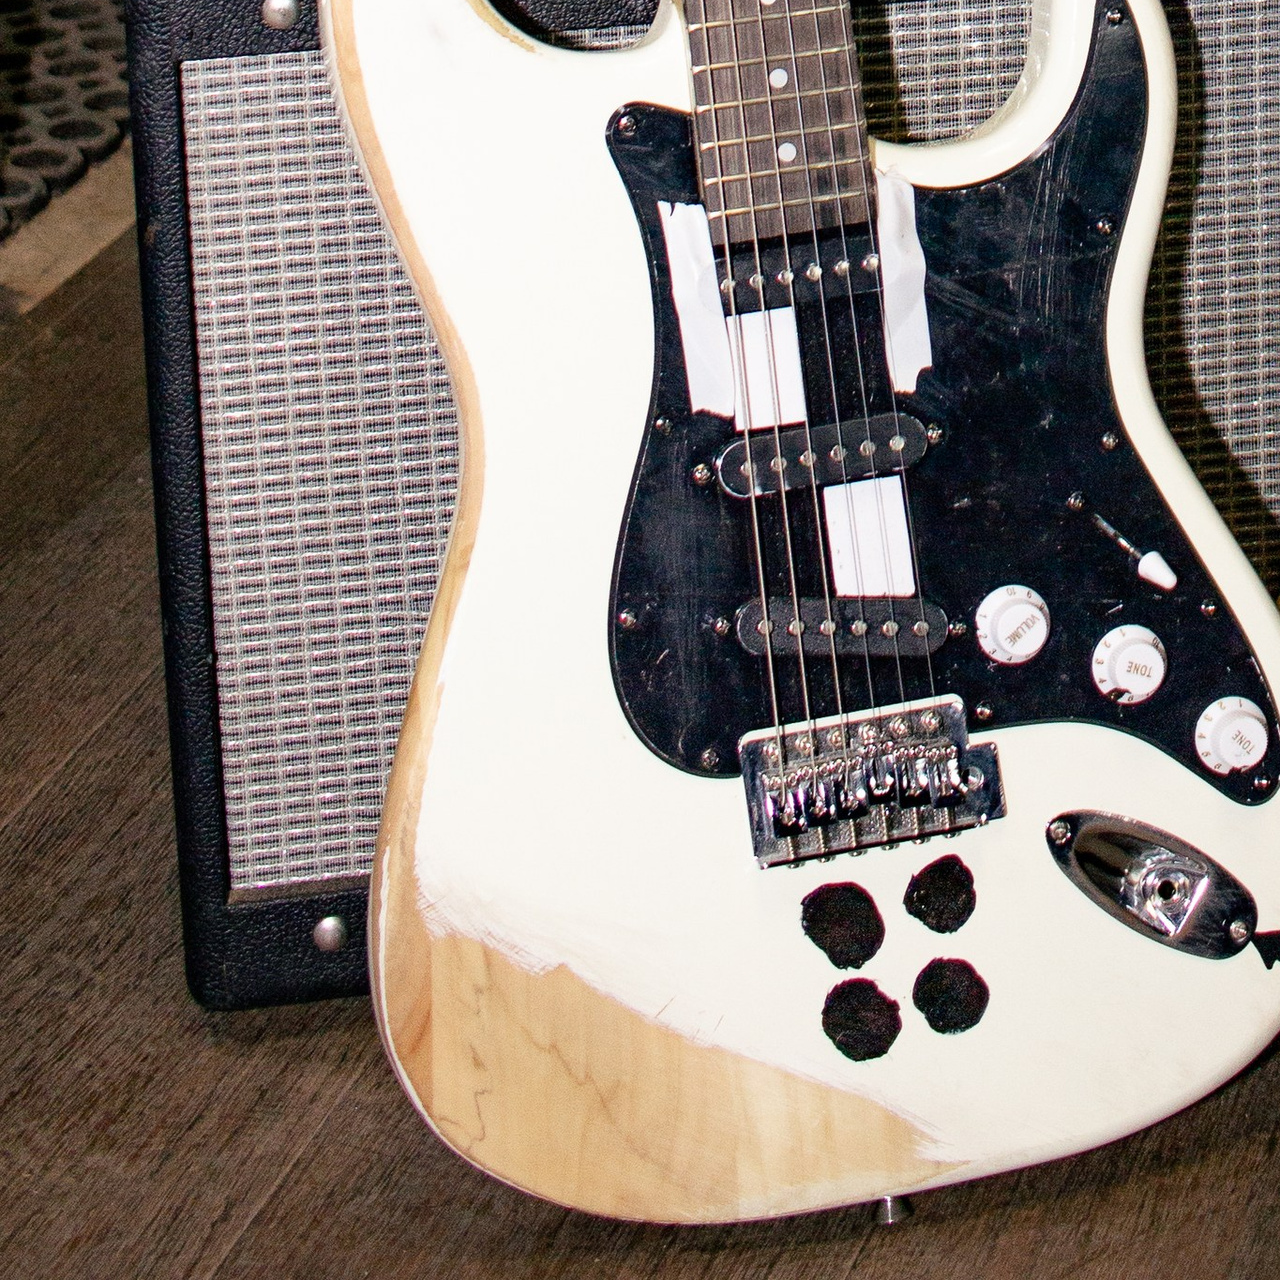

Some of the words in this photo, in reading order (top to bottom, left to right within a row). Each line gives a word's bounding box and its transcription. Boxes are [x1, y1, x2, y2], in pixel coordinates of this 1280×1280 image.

[1004, 613, 1041, 648] VOLUME
[1126, 660, 1153, 678] TONE
[1231, 729, 1255, 755] TONE
